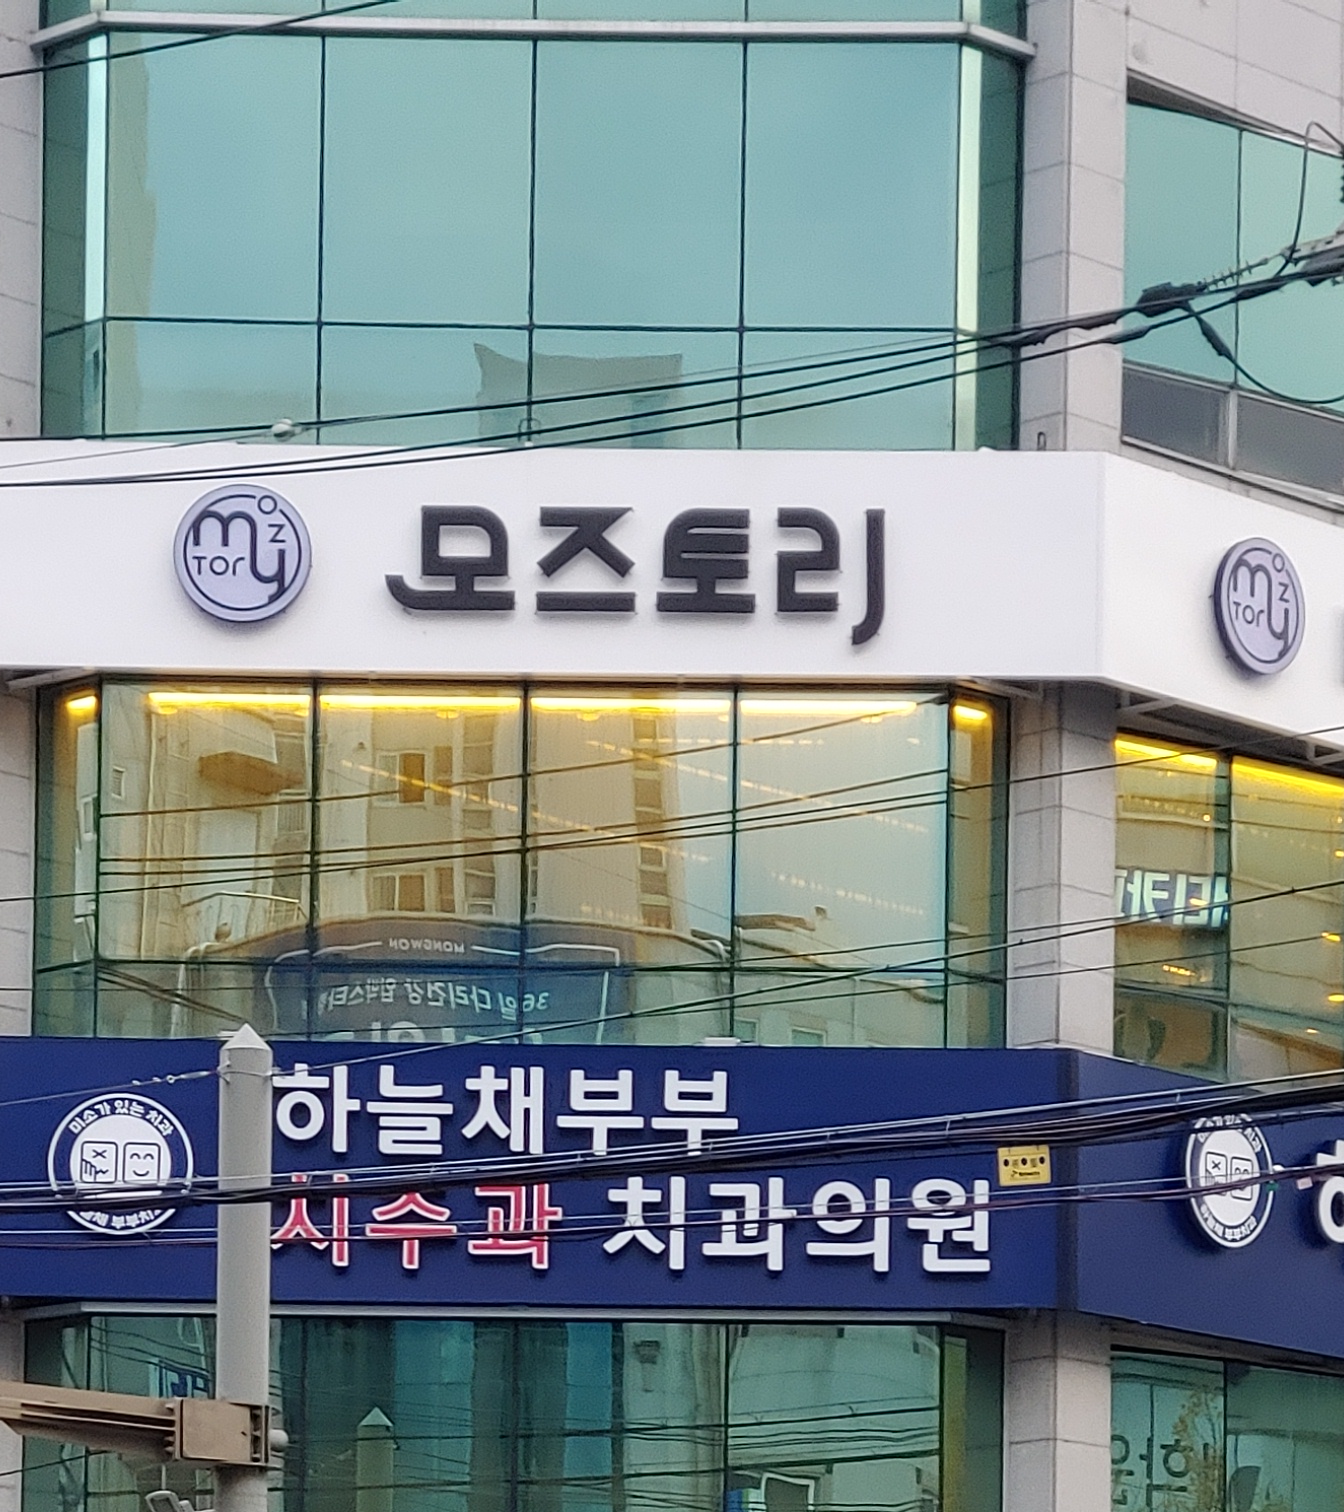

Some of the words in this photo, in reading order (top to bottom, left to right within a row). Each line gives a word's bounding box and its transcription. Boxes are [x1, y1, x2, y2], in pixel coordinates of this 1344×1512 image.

[384, 503, 887, 646] 모즈토리
[113, 1099, 145, 1117] 있는
[146, 1104, 175, 1136] 치과
[274, 1063, 740, 1158] 하늘채부부
[603, 1176, 992, 1274] 치과의원
